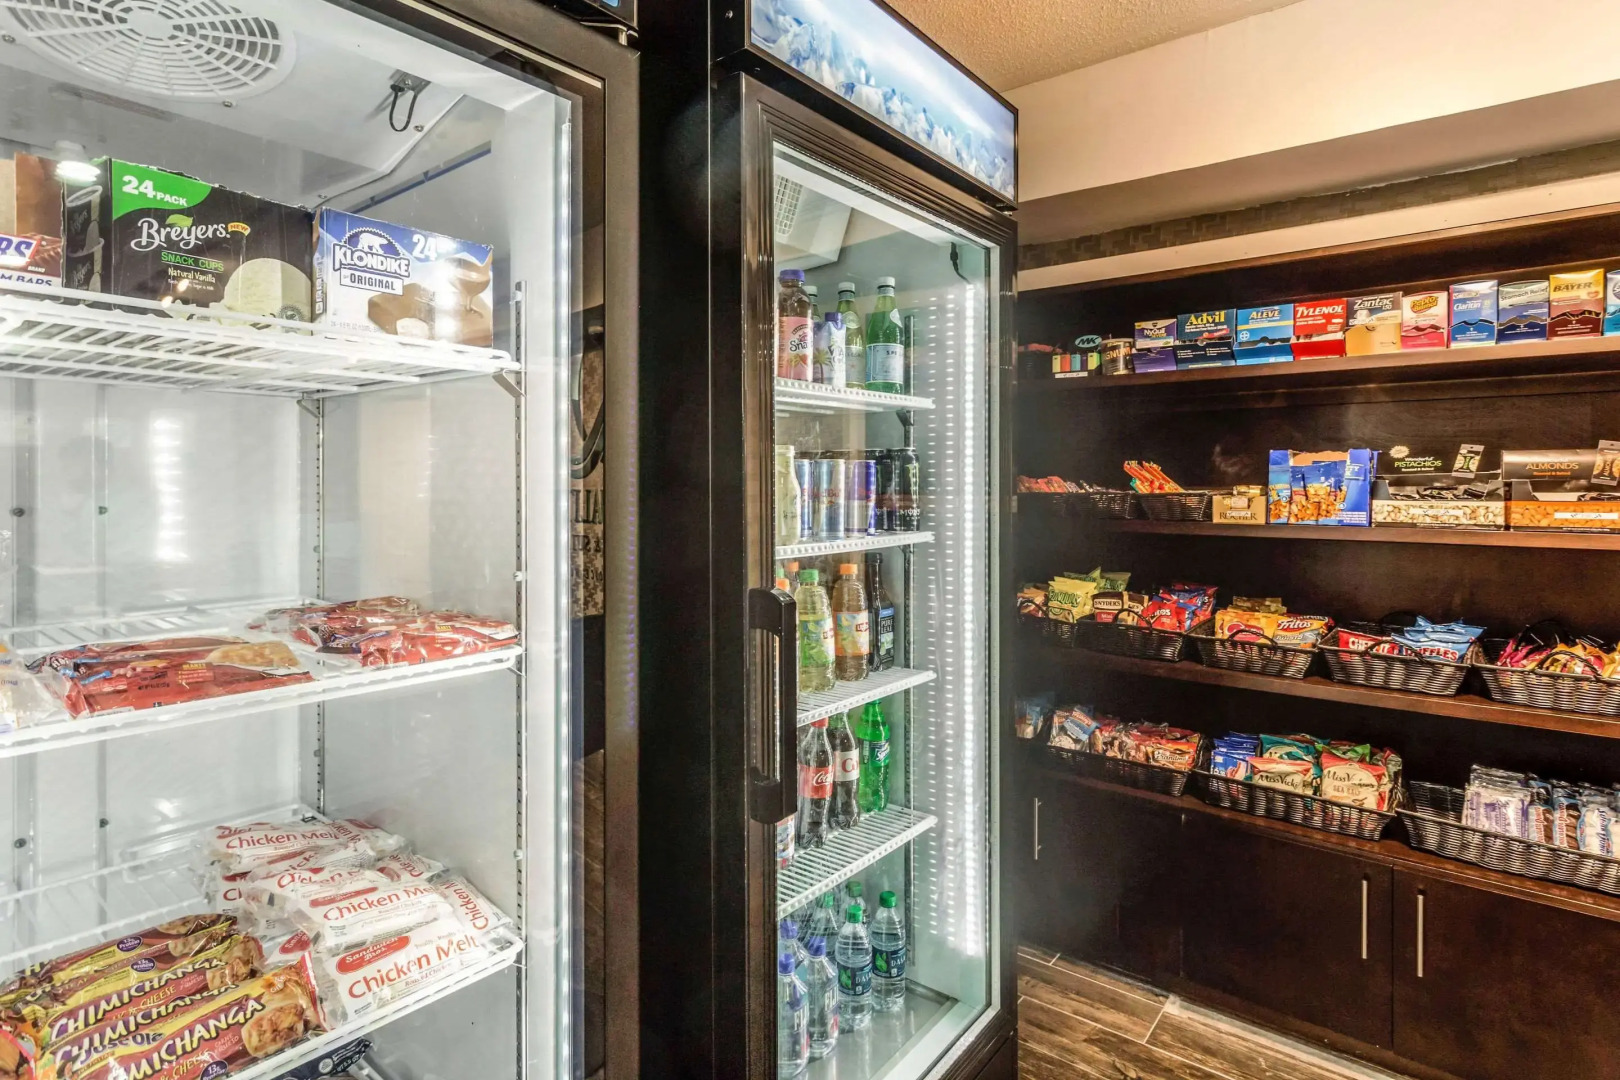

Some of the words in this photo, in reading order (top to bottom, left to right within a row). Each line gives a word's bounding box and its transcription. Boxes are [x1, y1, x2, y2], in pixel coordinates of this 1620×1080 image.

[122, 175, 156, 198] 24
[156, 191, 188, 207] PACK
[230, 222, 249, 233] NEW
[412, 234, 438, 261] 24
[161, 251, 194, 266] SNACK
[199, 259, 224, 272] CUPS
[333, 243, 410, 278] KLONDIKE
[168, 267, 194, 280] Natural
[194, 271, 216, 283] Vanilla
[350, 272, 396, 291] ORIGINAL
[1500, 291, 1526, 302] Stomach
[1529, 286, 1549, 296] Relief
[1553, 281, 1592, 293] BAYER
[1354, 298, 1393, 309] Zantac
[1454, 302, 1481, 311] Claritin
[1186, 311, 1225, 326] Advil
[1249, 310, 1281, 319] ALEVE
[1296, 305, 1344, 318] TYLENOL
[1143, 327, 1166, 337] NyQuil
[1526, 462, 1579, 470] ALMONDS
[1278, 619, 1312, 630] Fritos
[1258, 774, 1279, 784] Miss
[1324, 770, 1346, 783] Miss
[1333, 785, 1345, 794] SEA
[226, 832, 297, 849] Chicken
[323, 892, 400, 921] Chicken
[345, 937, 399, 964] Sandwich
[348, 954, 431, 998] Chicken
[436, 934, 479, 962] Melt
[52, 958, 228, 1042] CHIMICHANGA
[140, 985, 176, 1009] CHEESE
